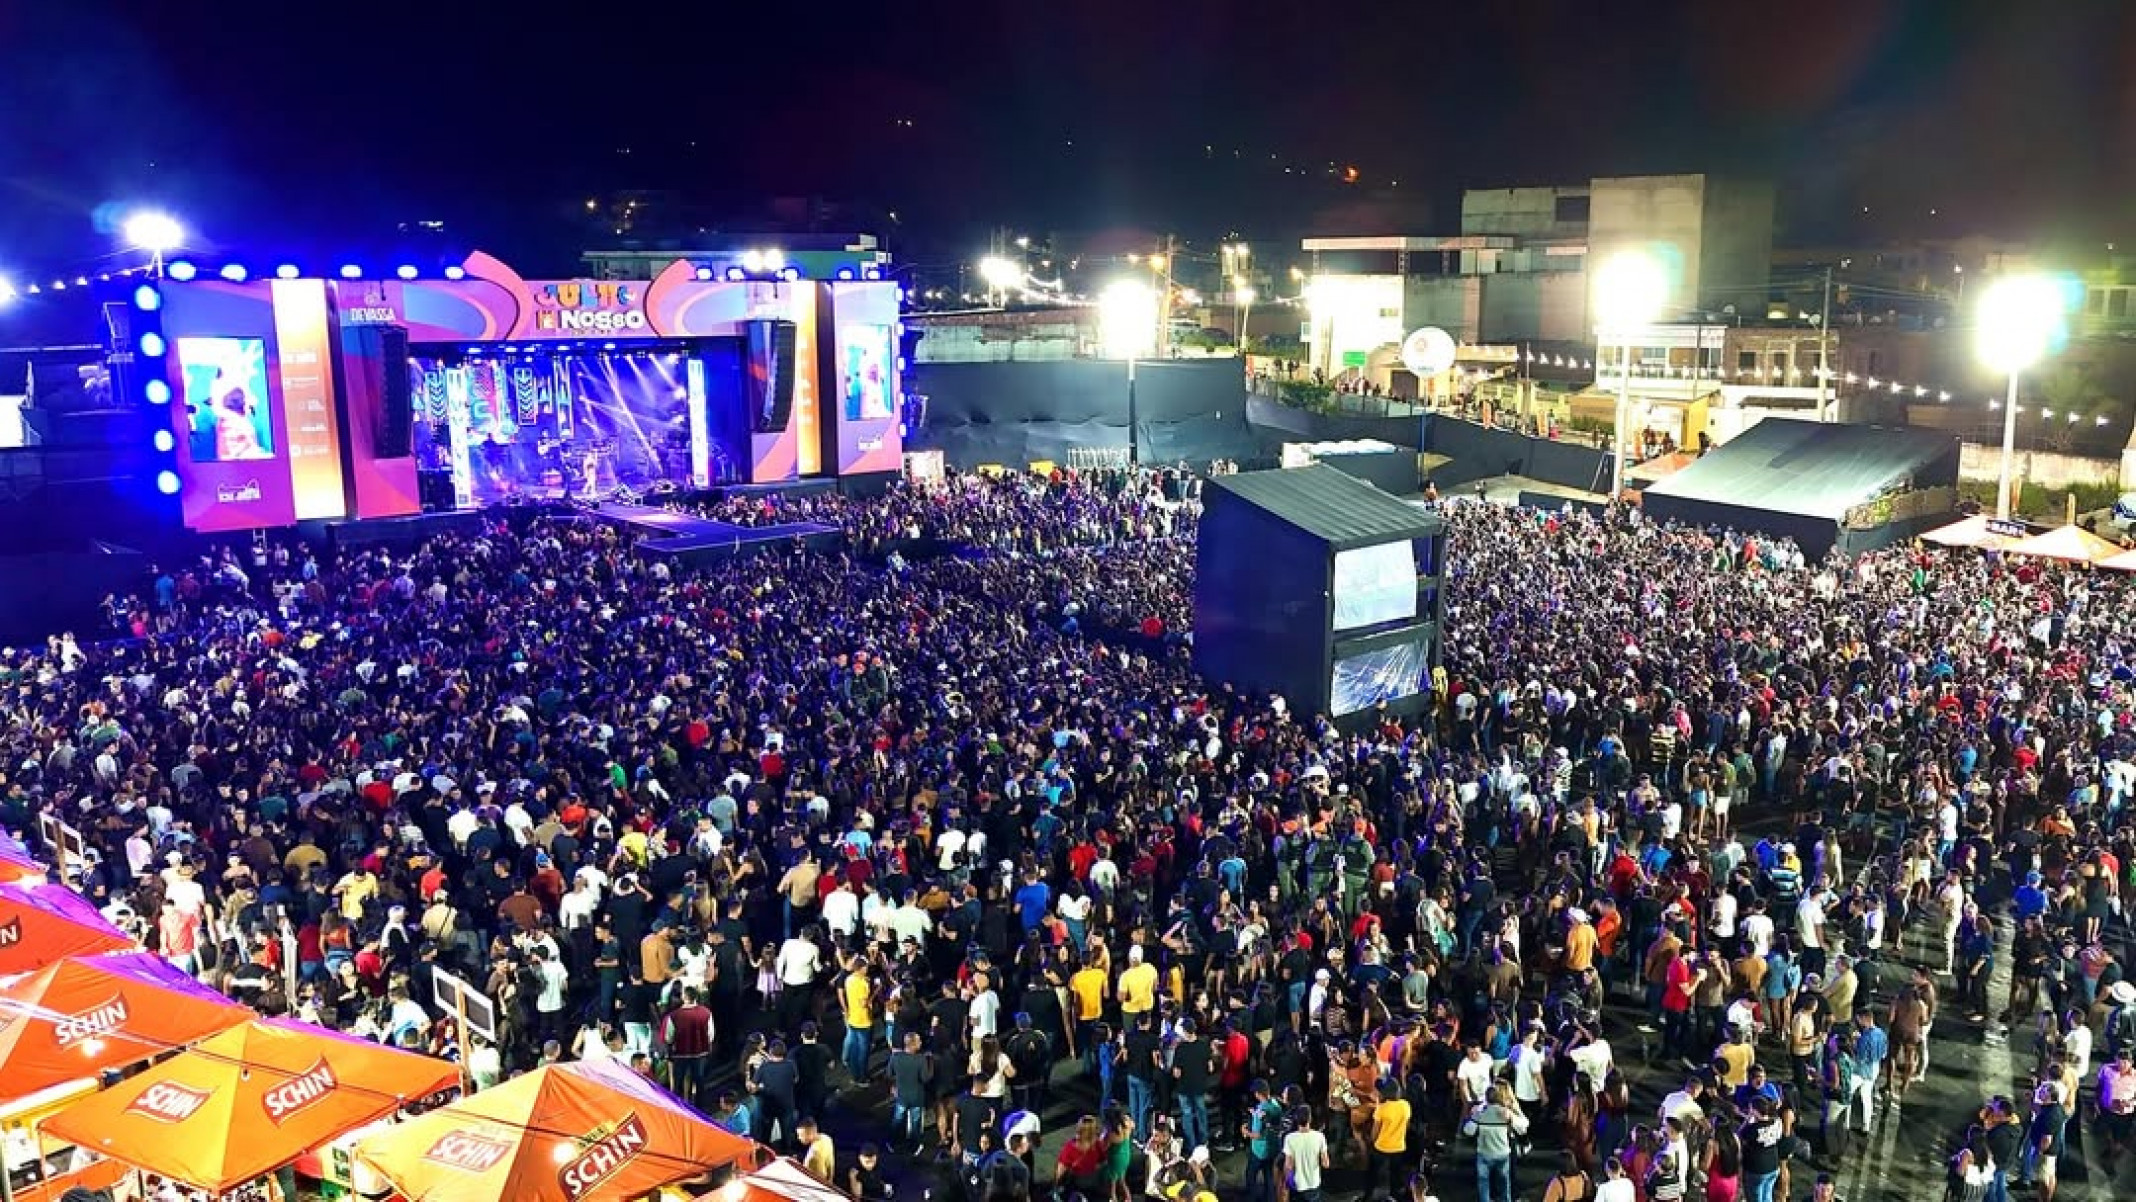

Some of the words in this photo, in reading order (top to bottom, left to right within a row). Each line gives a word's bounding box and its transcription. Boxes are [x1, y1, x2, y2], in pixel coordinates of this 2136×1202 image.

[350, 307, 396, 321] DEVASSA
[561, 309, 645, 329] NOSSO
[55, 1001, 127, 1044] SCHIN
[135, 1083, 205, 1119] SCHIN
[265, 1067, 335, 1117] SCHIN
[430, 1135, 508, 1169] SCHIN
[565, 1122, 645, 1196] SCHIN
